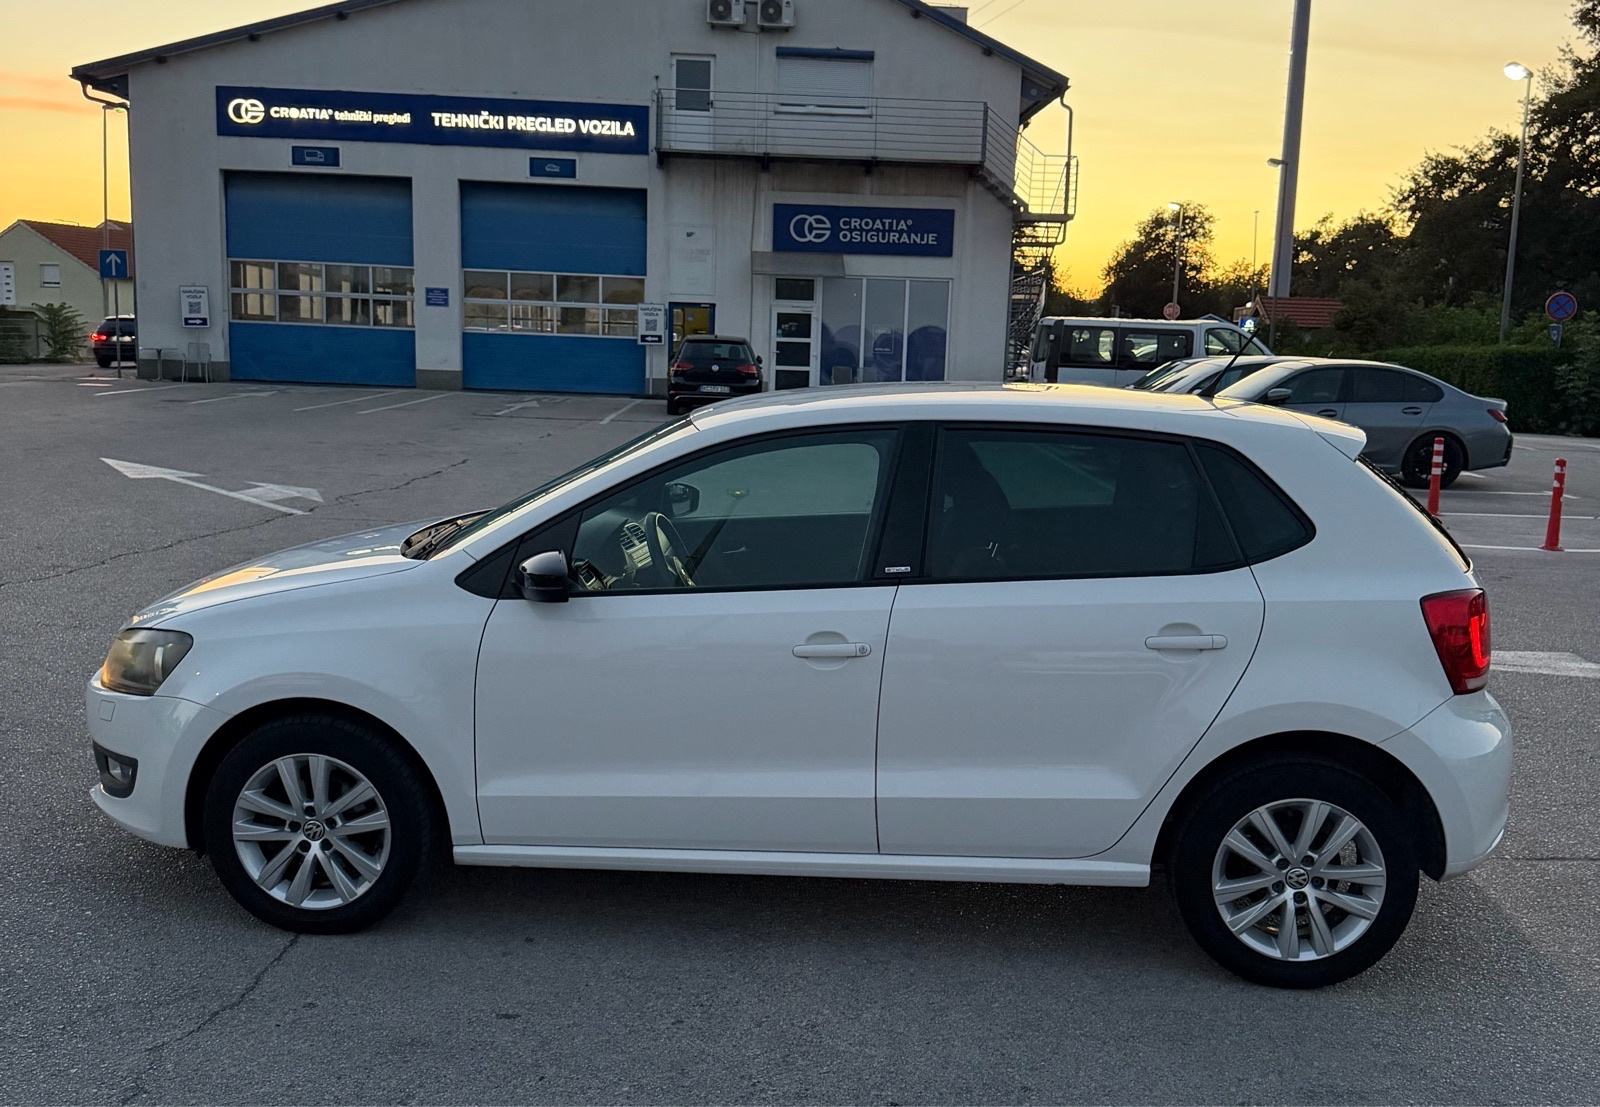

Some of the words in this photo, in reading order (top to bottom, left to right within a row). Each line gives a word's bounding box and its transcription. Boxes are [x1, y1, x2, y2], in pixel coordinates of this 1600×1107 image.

[373, 112, 411, 125] pregledi
[431, 111, 504, 129] TEHNIČKI
[507, 115, 577, 133] PREGLED
[578, 119, 635, 136] VOZILA
[839, 230, 938, 244] OSIGURANJE
